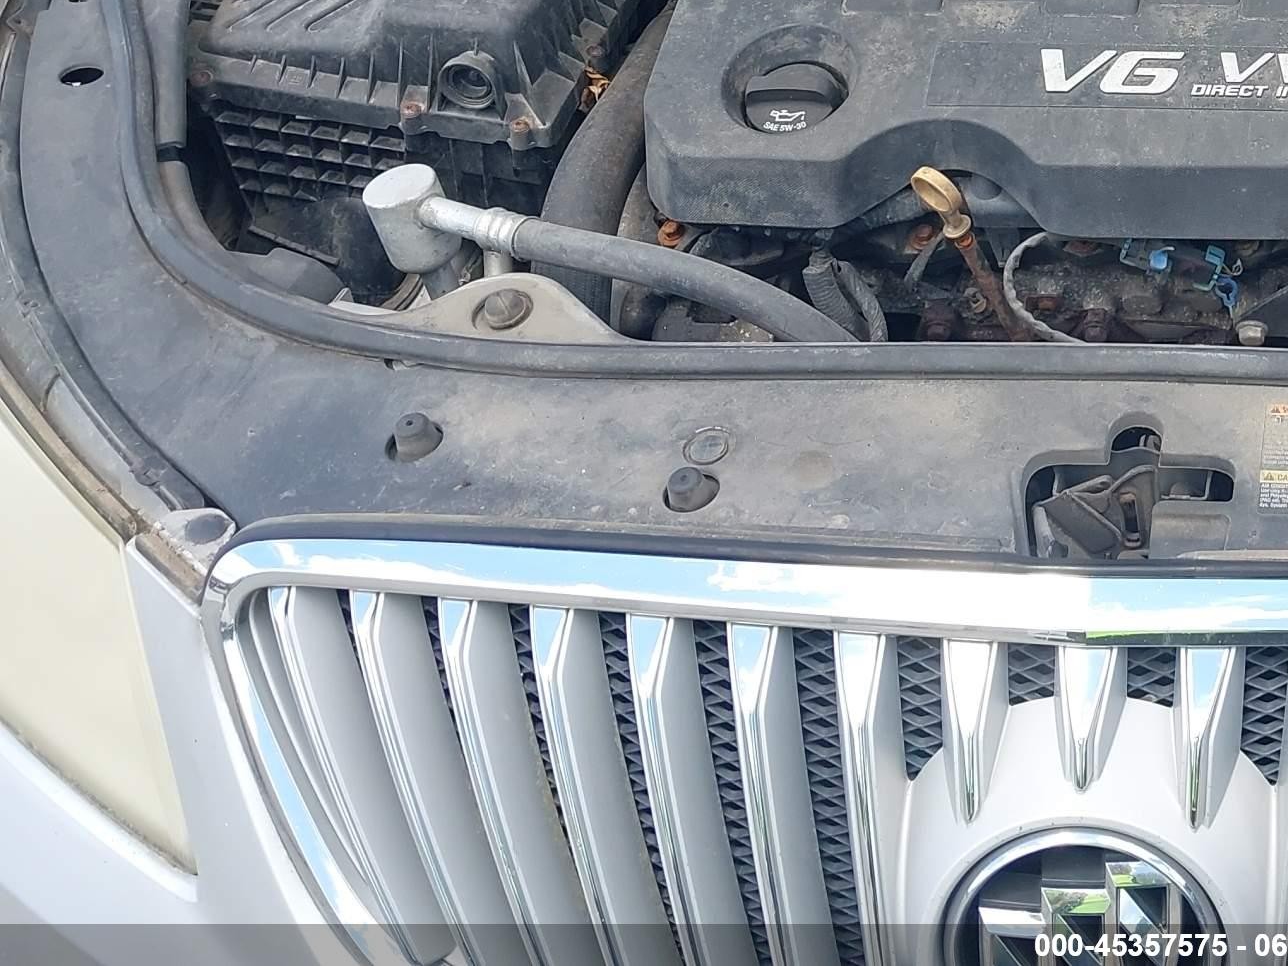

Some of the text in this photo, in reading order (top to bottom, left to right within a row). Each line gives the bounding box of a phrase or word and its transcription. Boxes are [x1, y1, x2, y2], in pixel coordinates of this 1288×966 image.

[1040, 48, 1185, 94] V6
[1191, 85, 1268, 98] DIRECT
[763, 121, 807, 132] SAE 5W-30
